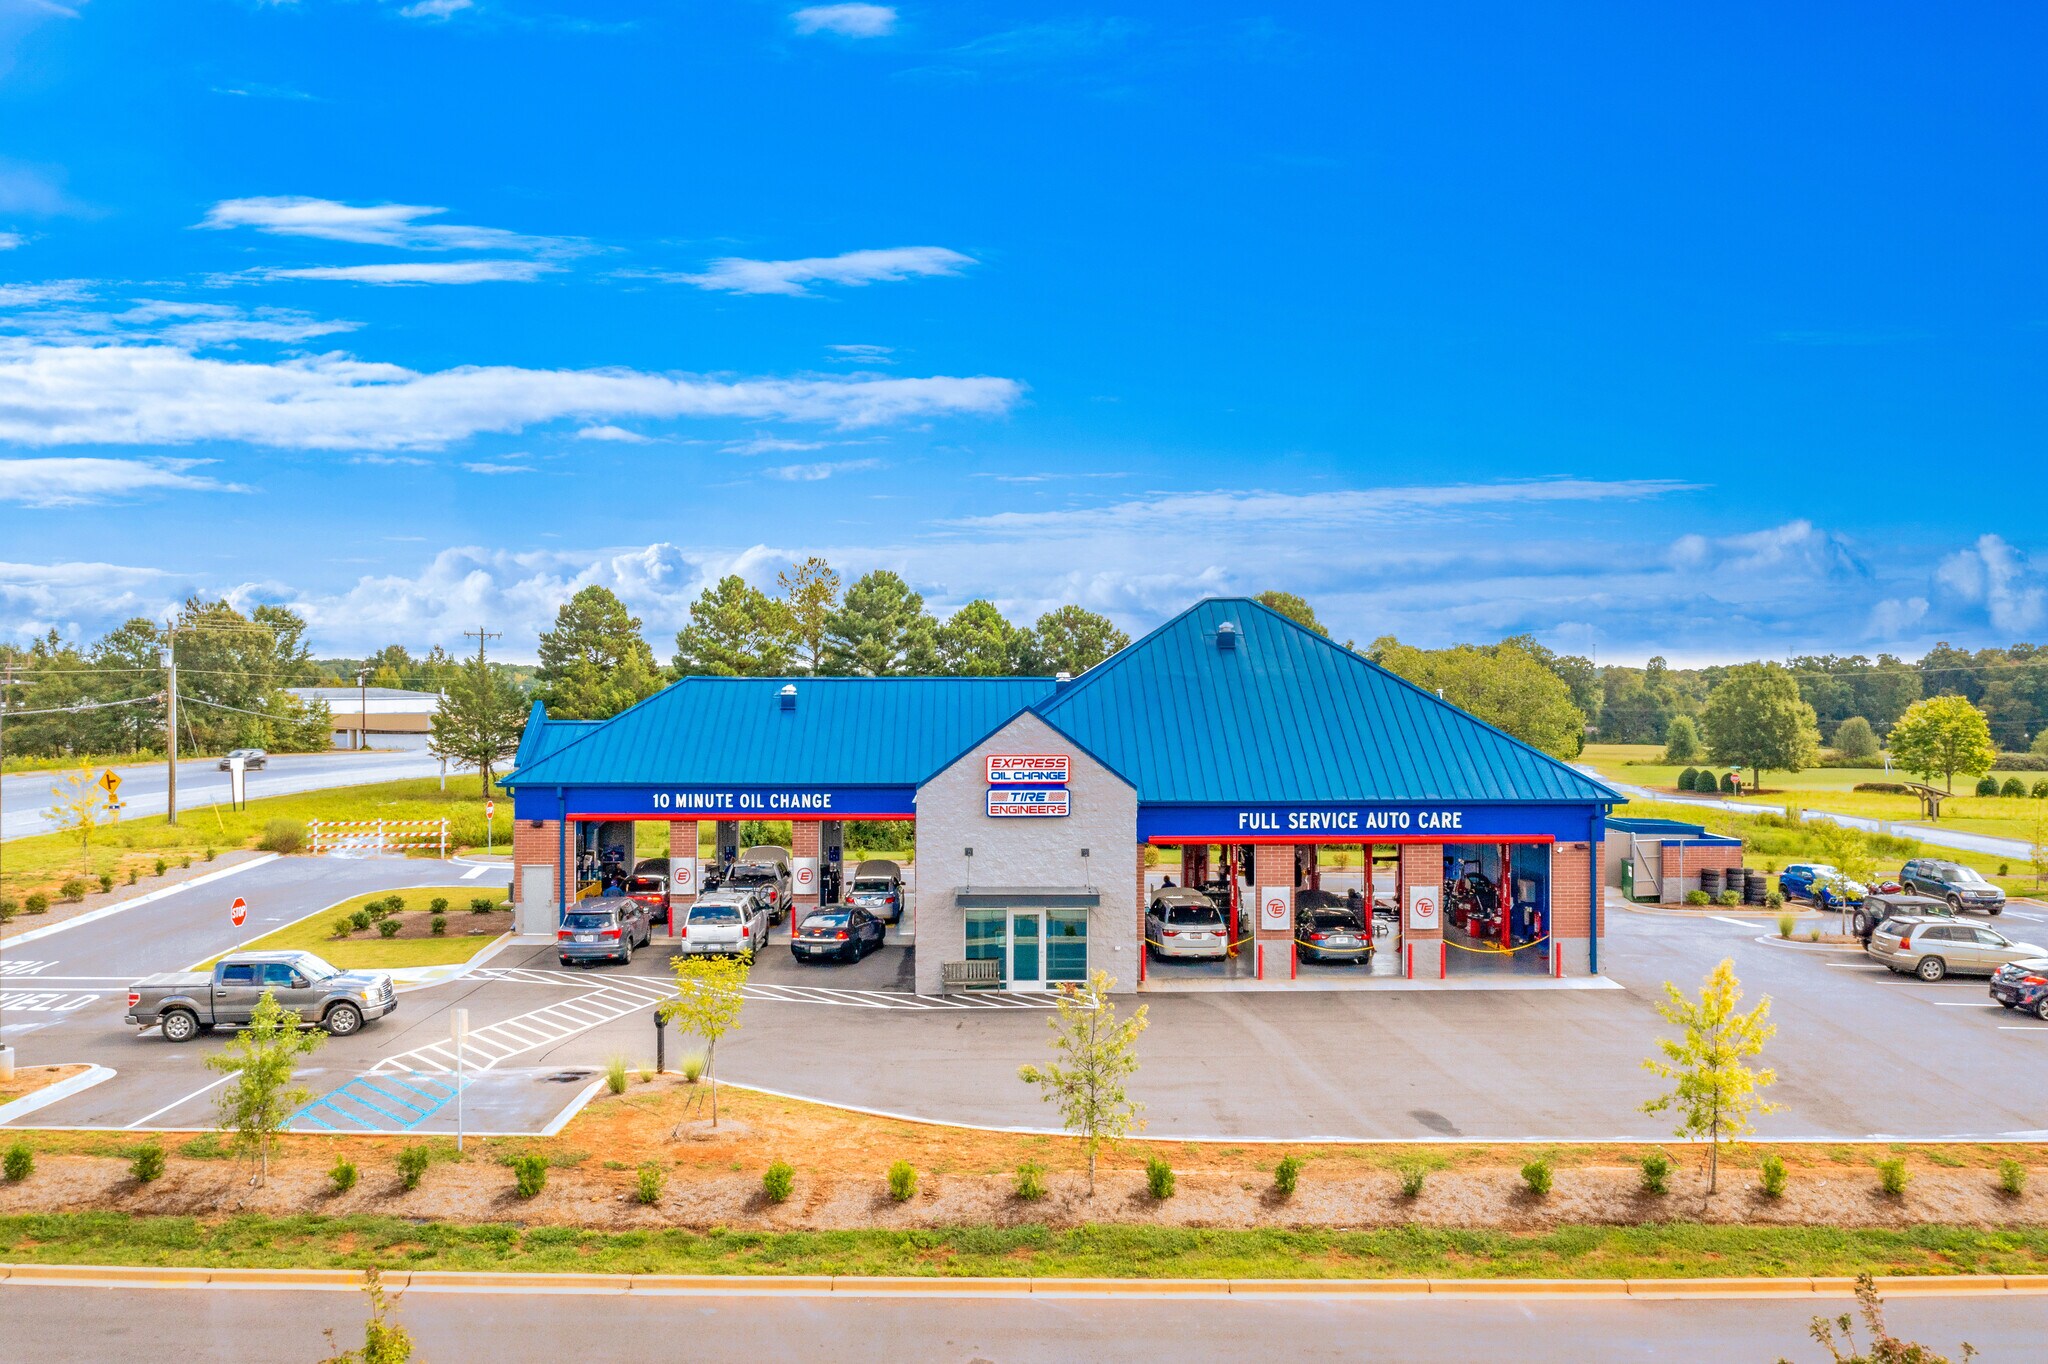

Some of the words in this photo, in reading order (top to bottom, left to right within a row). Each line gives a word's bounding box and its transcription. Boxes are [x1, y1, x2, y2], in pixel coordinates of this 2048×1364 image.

[991, 758, 1067, 768] EXPRESS
[991, 771, 1011, 780] OIL
[1013, 771, 1066, 780] CHANGE
[652, 793, 670, 808] 10
[675, 793, 734, 808] MINUTE
[739, 793, 765, 808] OIL
[769, 793, 832, 808] CHANGE
[1011, 792, 1047, 802] TIRE
[990, 805, 1067, 814] ENGINEERS
[1239, 812, 1280, 829] FULL
[1288, 812, 1359, 829] SERVICE
[1366, 812, 1411, 829] AUTO
[1418, 812, 1463, 829] CARE
[677, 871, 688, 881] E
[800, 871, 811, 881] E
[231, 905, 246, 918] STOP
[1269, 903, 1284, 915] TE
[1418, 902, 1433, 914] TE
